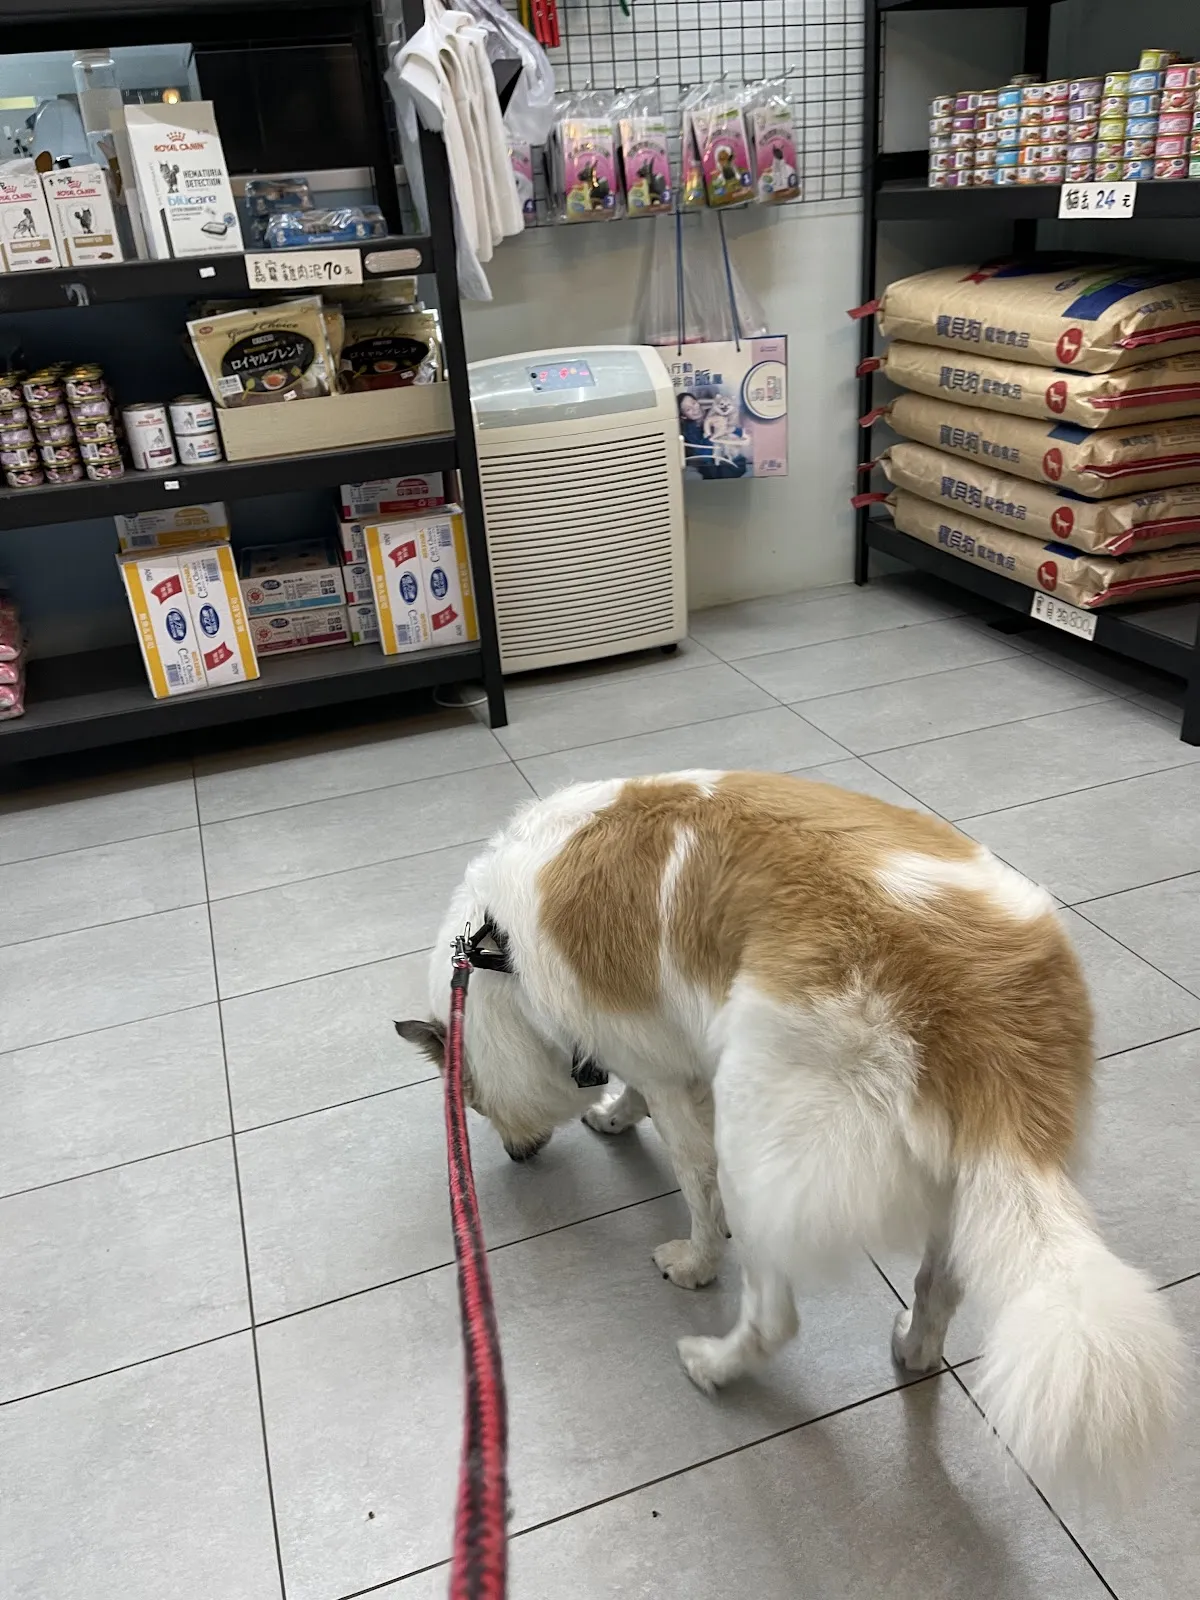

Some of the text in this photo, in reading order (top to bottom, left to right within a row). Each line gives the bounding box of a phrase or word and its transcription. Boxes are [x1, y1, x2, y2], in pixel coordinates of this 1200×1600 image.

[154, 142, 204, 153] ROYAL CANIN
[183, 168, 222, 178] HEMATURIA
[185, 179, 221, 188] DETECTION
[1095, 189, 1116, 209] 24
[936, 314, 982, 343] 寶貝狗
[231, 343, 304, 370] ロイヤルブレンド
[939, 366, 980, 395] 寶貝狗
[939, 424, 979, 454] 寶貝狗
[941, 476, 982, 508] 寶貝狗
[938, 525, 976, 557] 寶貝狗
